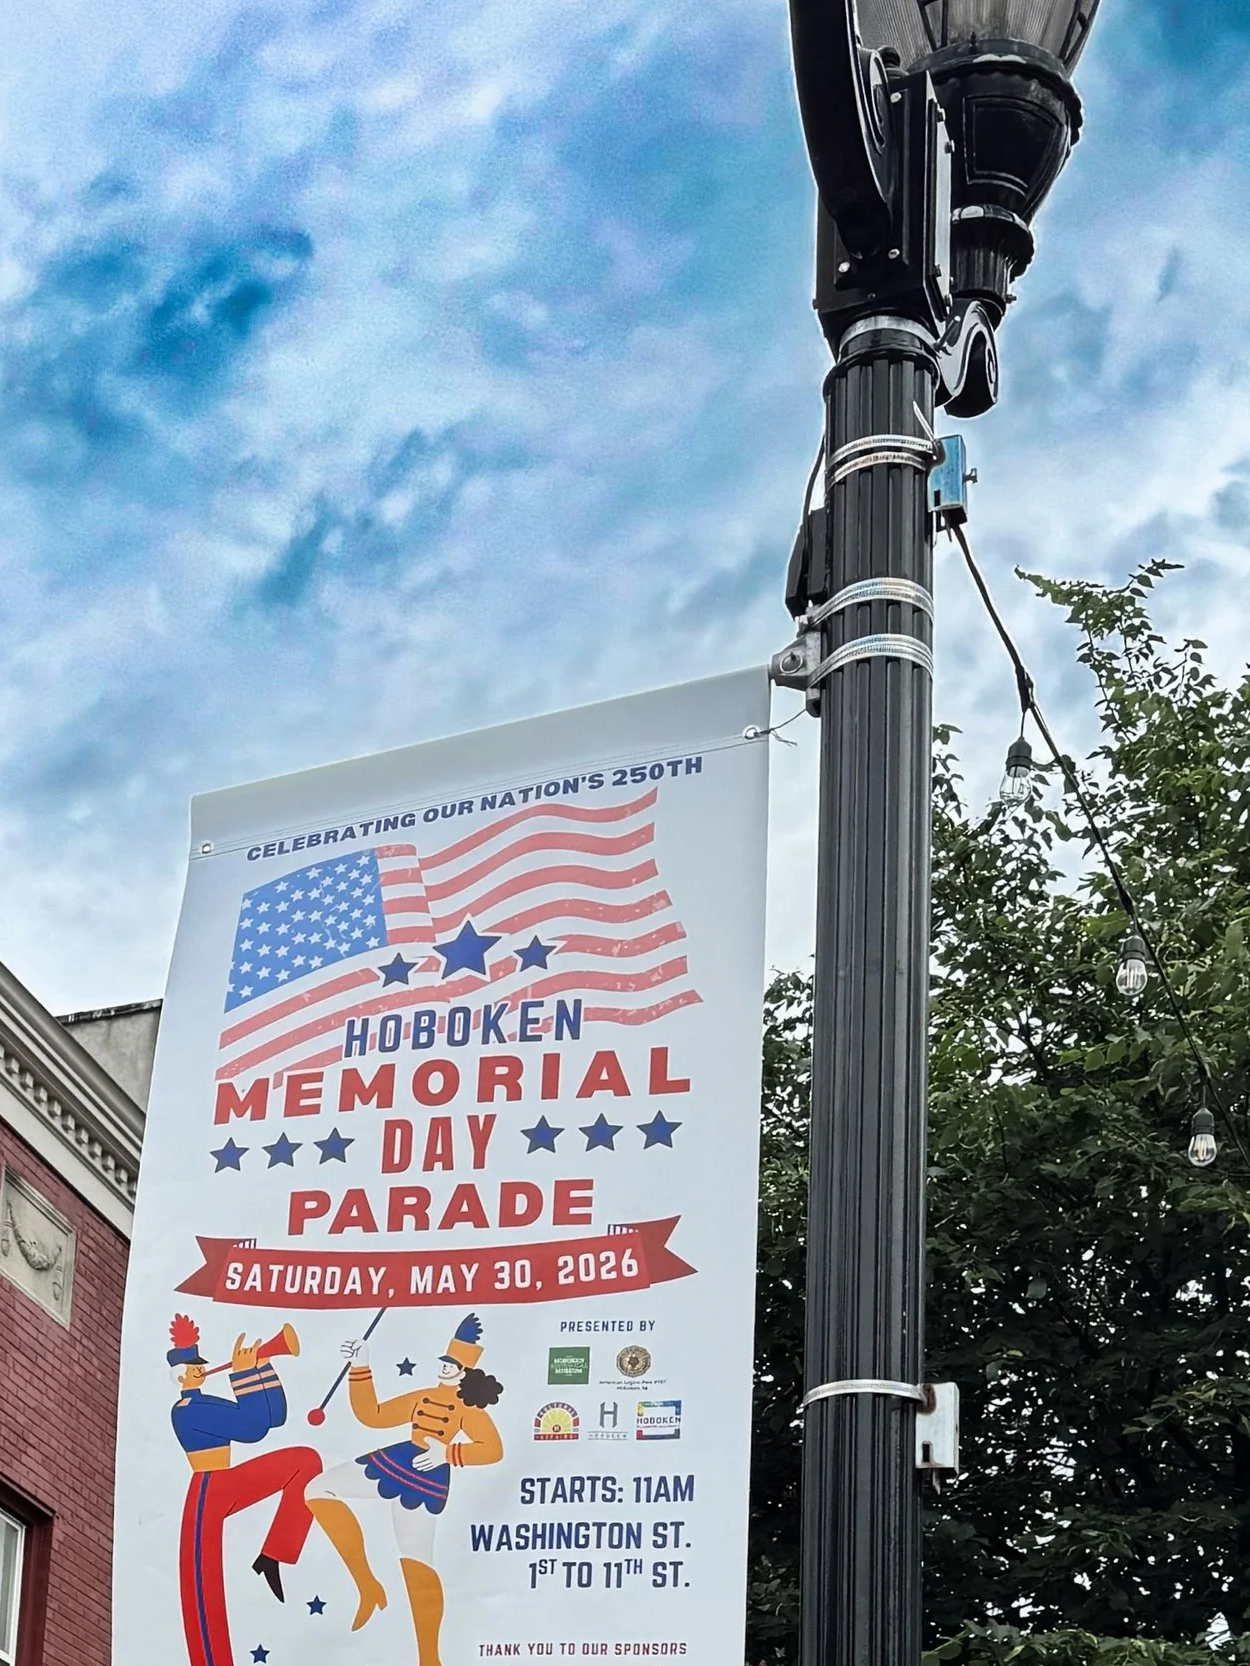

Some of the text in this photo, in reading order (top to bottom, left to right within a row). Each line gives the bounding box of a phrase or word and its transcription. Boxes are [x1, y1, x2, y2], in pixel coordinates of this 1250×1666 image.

[247, 756, 703, 861] CELEBRATING OUR NATION'S 250TH
[344, 999, 582, 1057] HOBOKEN
[214, 1046, 691, 1125] MEMORIAL
[381, 1114, 497, 1173] DAY
[288, 1178, 594, 1235] PARADE
[225, 1248, 639, 1299] SATURDAY, MAY 30, 2026
[560, 1320, 656, 1332] PRESENTED BY
[520, 1475, 694, 1504] STARTS: 11AM
[470, 1521, 692, 1552] WASHINGTON ST.
[529, 1559, 690, 1589] 1ST TO 11TH ST.
[479, 1643, 687, 1657] THANK YOU TO OUR SPONSORS
